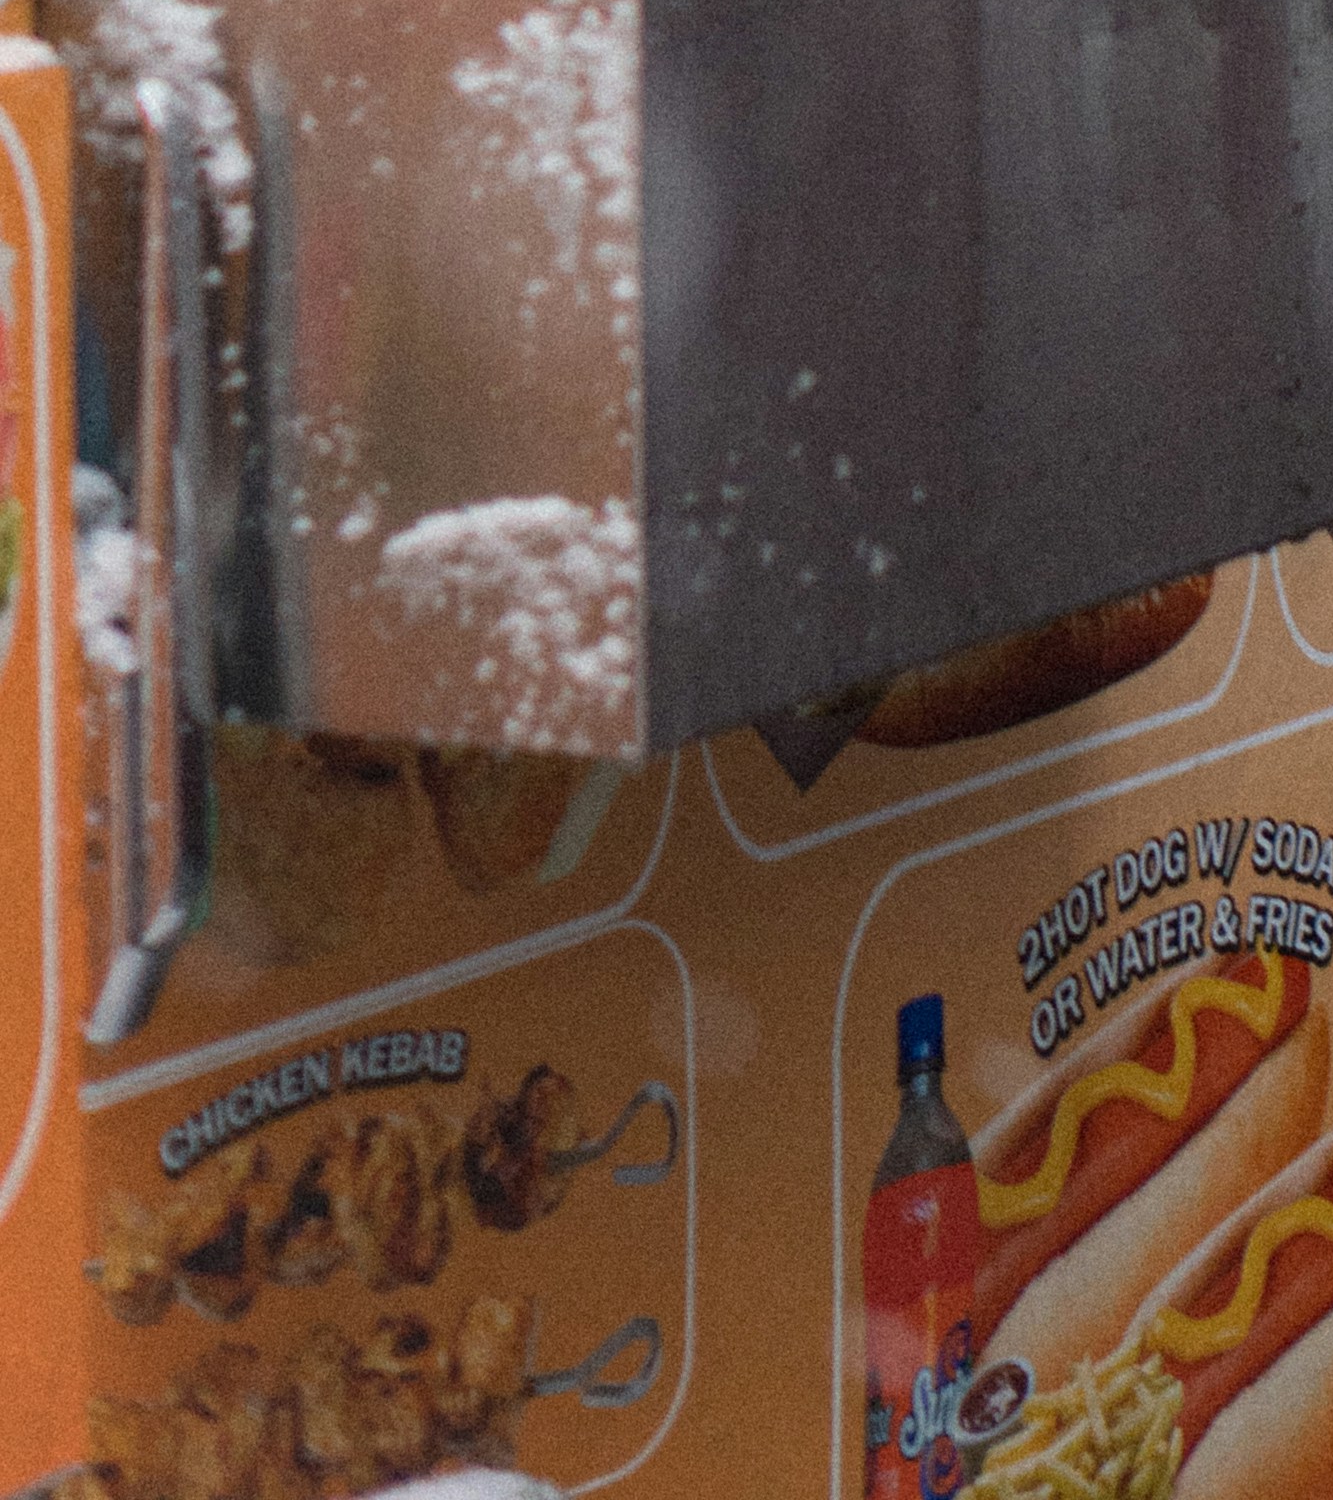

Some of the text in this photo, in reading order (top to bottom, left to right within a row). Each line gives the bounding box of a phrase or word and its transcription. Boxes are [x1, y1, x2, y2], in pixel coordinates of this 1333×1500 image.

[1114, 827, 1189, 913] DOG
[1194, 817, 1250, 887] W/
[1029, 973, 1085, 1058] OR
[1084, 901, 1206, 1010] WATER
[1210, 893, 1242, 955] &
[158, 1028, 470, 1181] CHICKEN KEBAB
